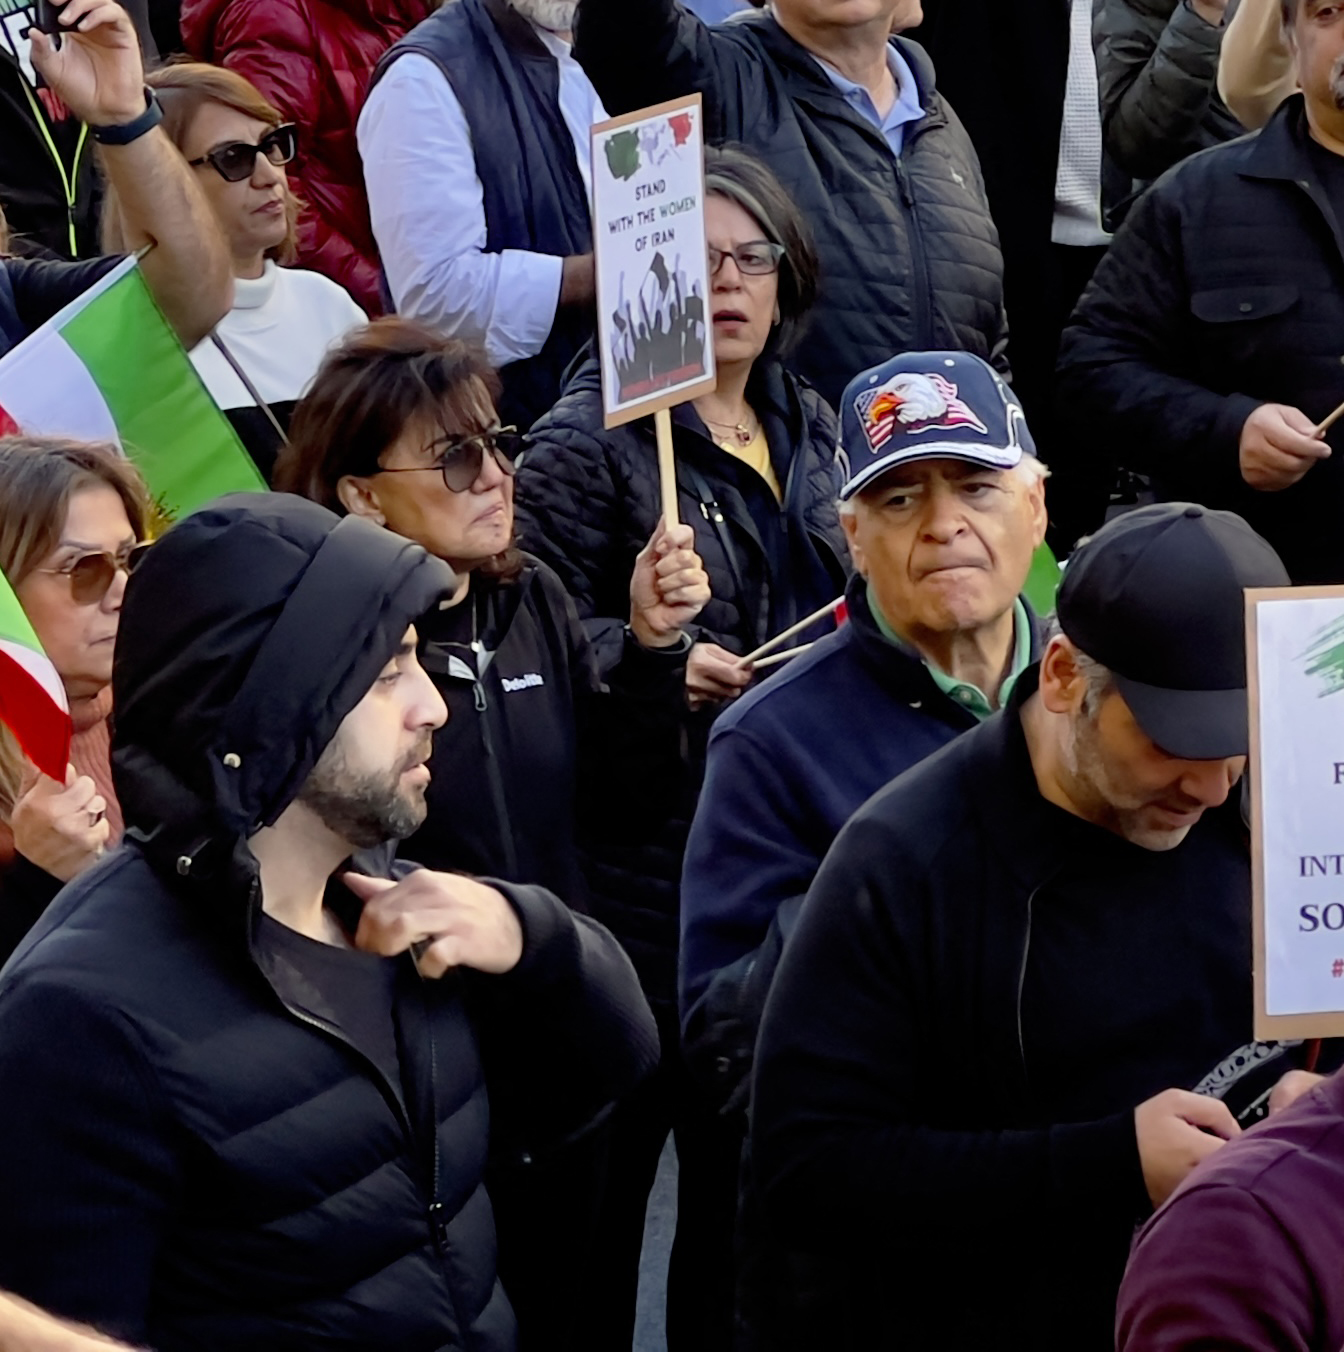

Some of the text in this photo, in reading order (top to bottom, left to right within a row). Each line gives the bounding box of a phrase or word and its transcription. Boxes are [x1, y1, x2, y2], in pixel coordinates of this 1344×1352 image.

[635, 178, 667, 201] STAND
[608, 195, 697, 235] WITH THE WOMEN
[634, 228, 676, 252] OF IRAN
